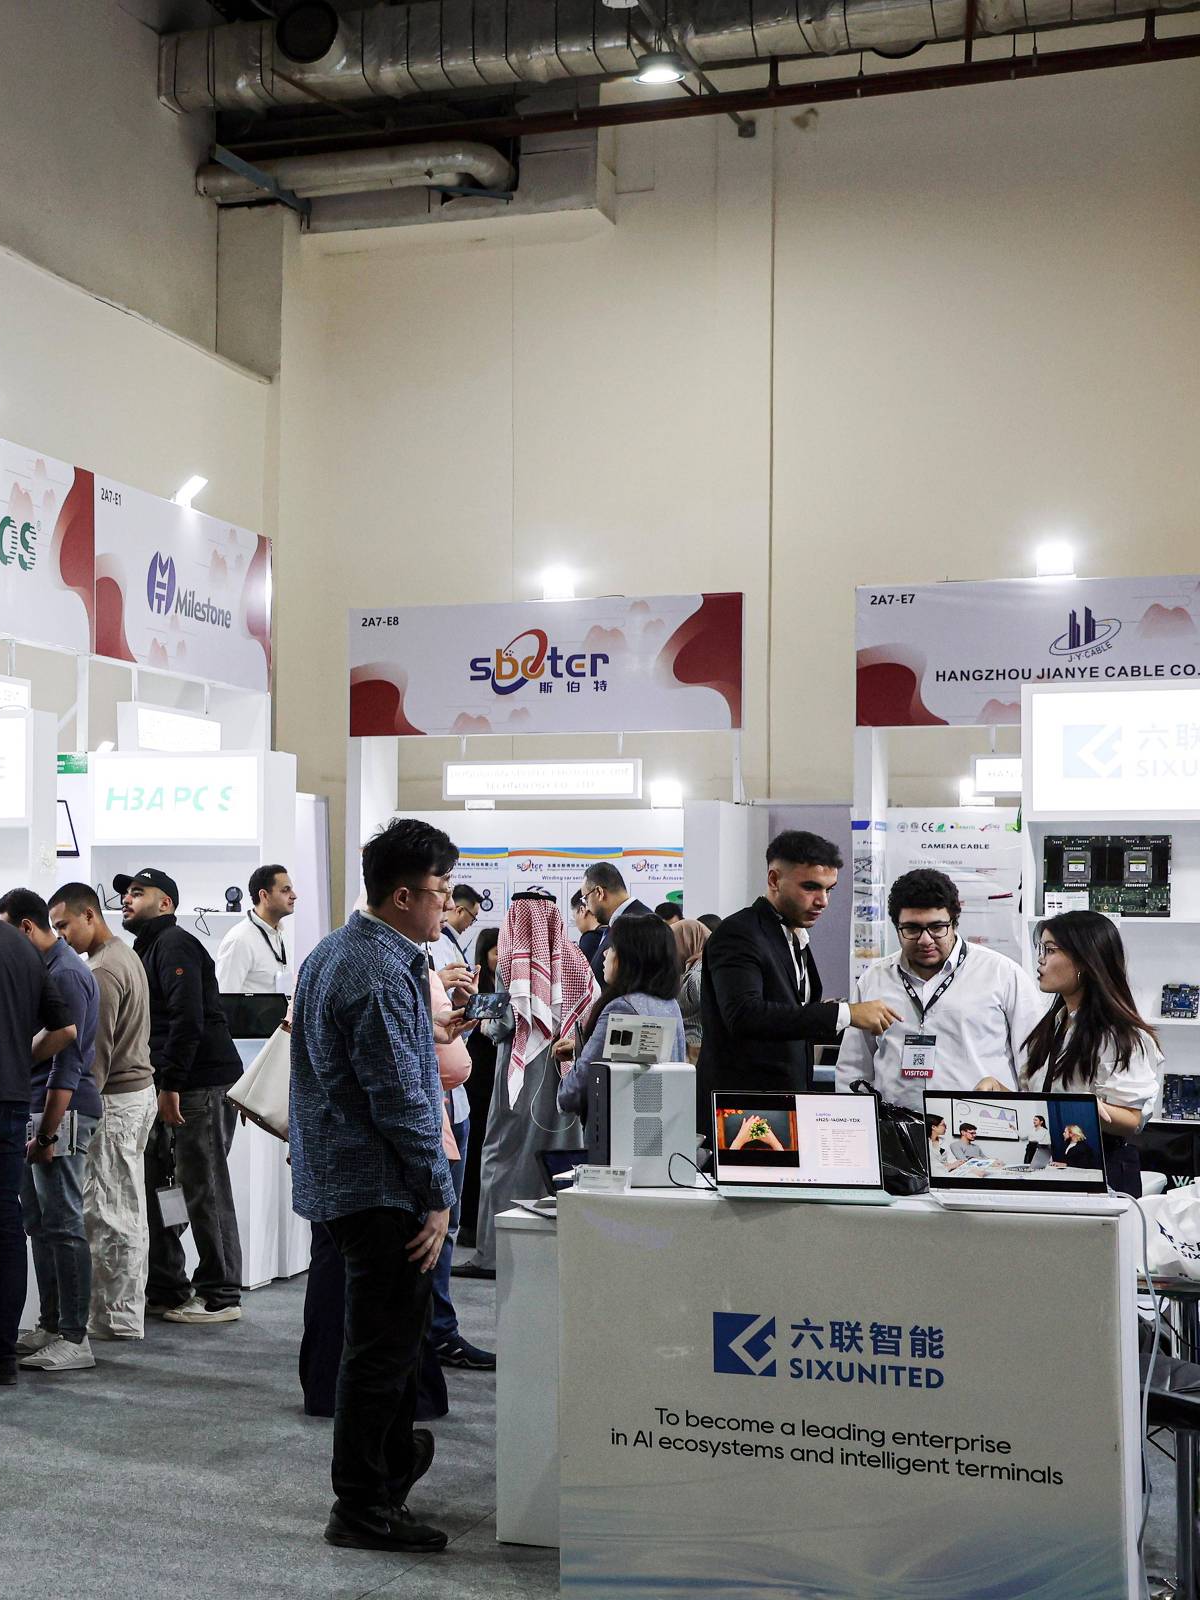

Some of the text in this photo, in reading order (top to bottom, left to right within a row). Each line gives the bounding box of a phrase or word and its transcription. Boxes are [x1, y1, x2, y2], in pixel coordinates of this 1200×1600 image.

[101, 488, 122, 507] 2A7-E1
[175, 586, 231, 629] Milestone
[870, 593, 916, 606] 2A7-E7
[361, 616, 399, 627] 2A7-E8
[935, 668, 1032, 682] HANGZHOU
[1036, 667, 1099, 680] JIANYE
[1105, 665, 1165, 678] CABLE
[539, 680, 608, 694] 斯伯特
[790, 1317, 945, 1359] 六联智能
[789, 1358, 945, 1389] SIXUNITED
[655, 1407, 1012, 1455] To become a leading enterprise
[610, 1428, 1064, 1485] in AI ecosystems and intelligent terminals
